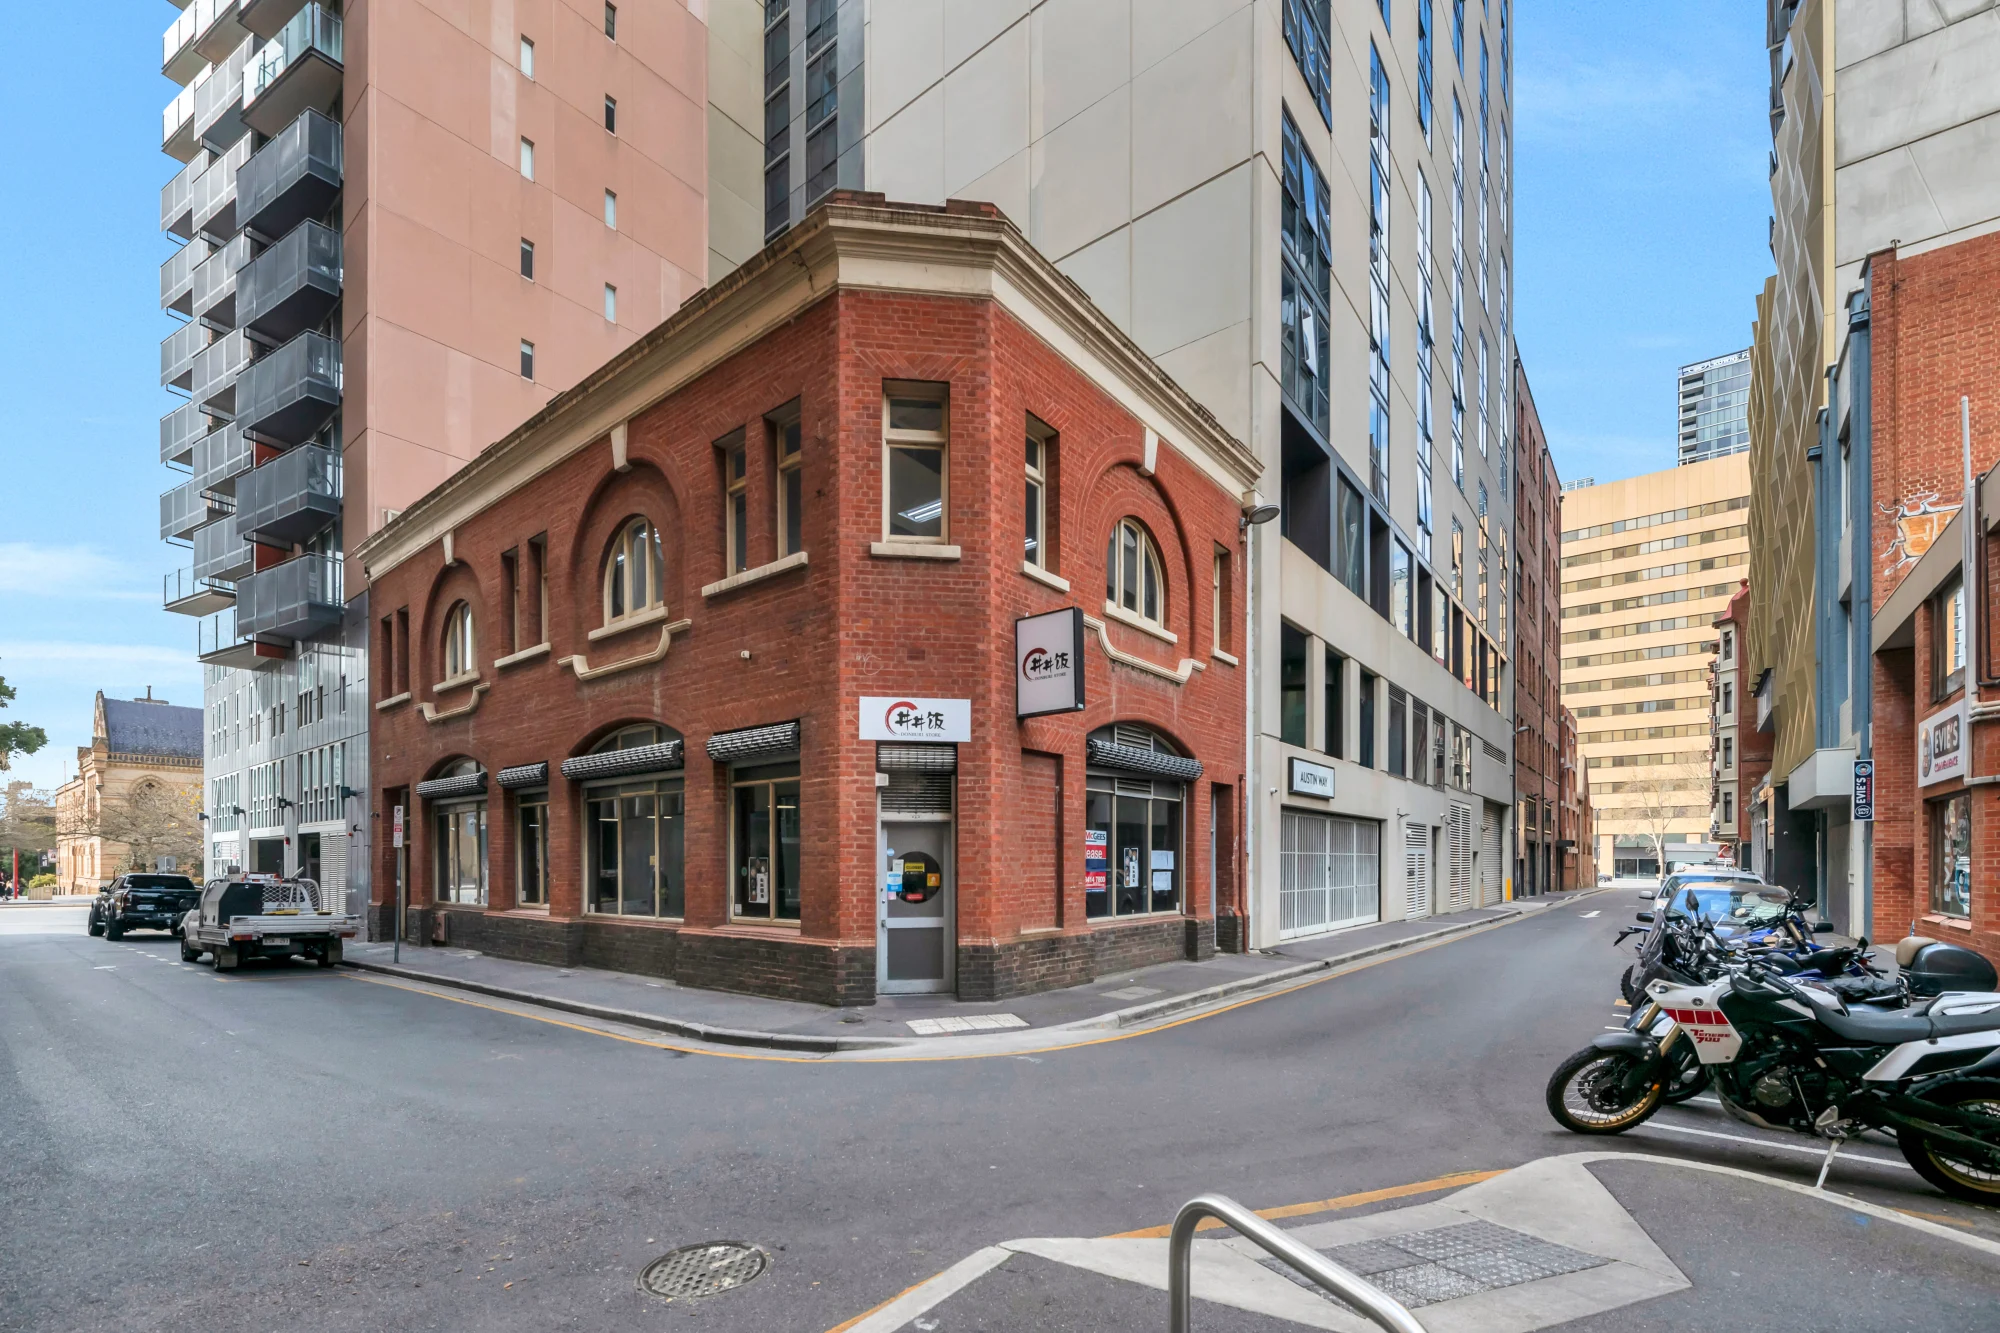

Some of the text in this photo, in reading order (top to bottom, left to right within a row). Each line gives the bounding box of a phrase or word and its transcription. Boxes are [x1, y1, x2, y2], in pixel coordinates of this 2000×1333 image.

[1934, 720, 1958, 754] EVIE'S
[1300, 772, 1328, 787] AUSTIN WAY
[1856, 777, 1866, 804] EVIE'S
[1086, 849, 1102, 859] ease
